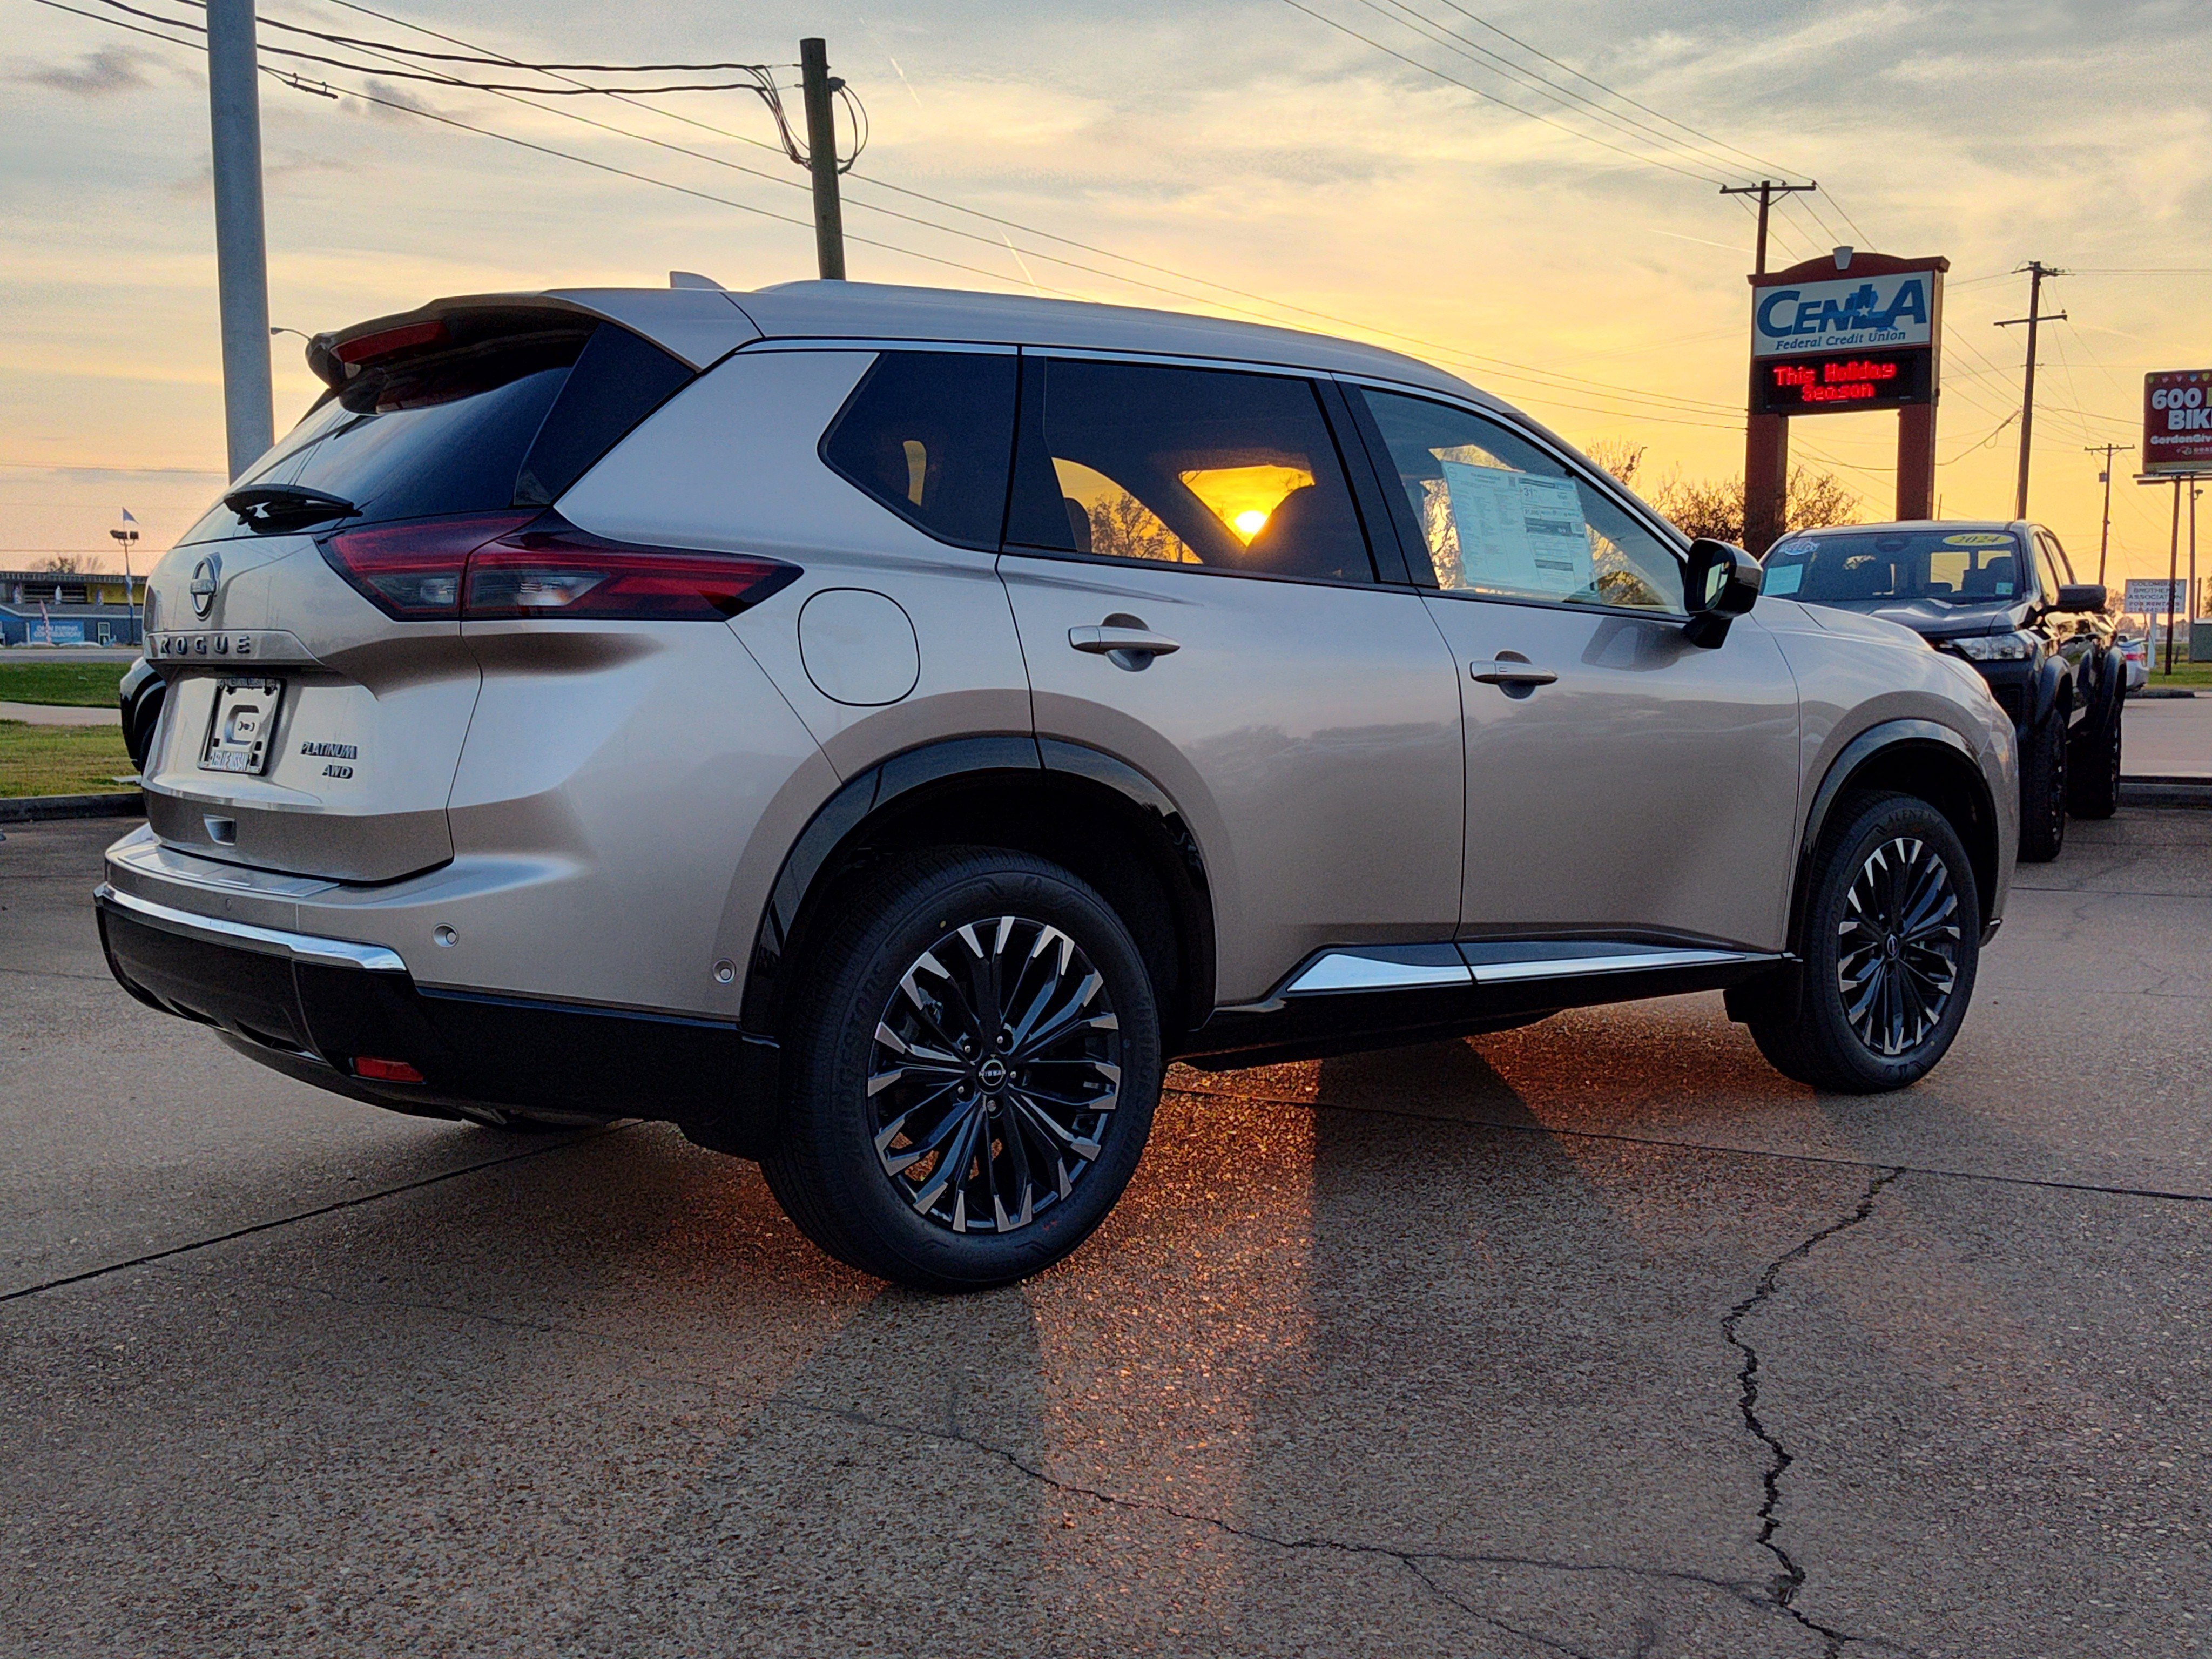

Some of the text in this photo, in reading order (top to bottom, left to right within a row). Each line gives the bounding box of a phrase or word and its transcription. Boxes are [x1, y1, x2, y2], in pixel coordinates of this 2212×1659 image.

[1775, 331, 1906, 350] Federal Credit Union
[1773, 361, 1897, 386] This Holiday
[1802, 383, 1875, 402] Season
[2152, 387, 2202, 410] 600
[2168, 408, 2212, 430] BIK
[2150, 434, 2212, 445] GordonGiv
[1954, 536, 2001, 544] 2024
[160, 636, 251, 656] ROGUE
[300, 741, 358, 760] PLATINUM
[322, 764, 354, 779] AWD
[978, 1069, 1007, 1077] NISSAN
